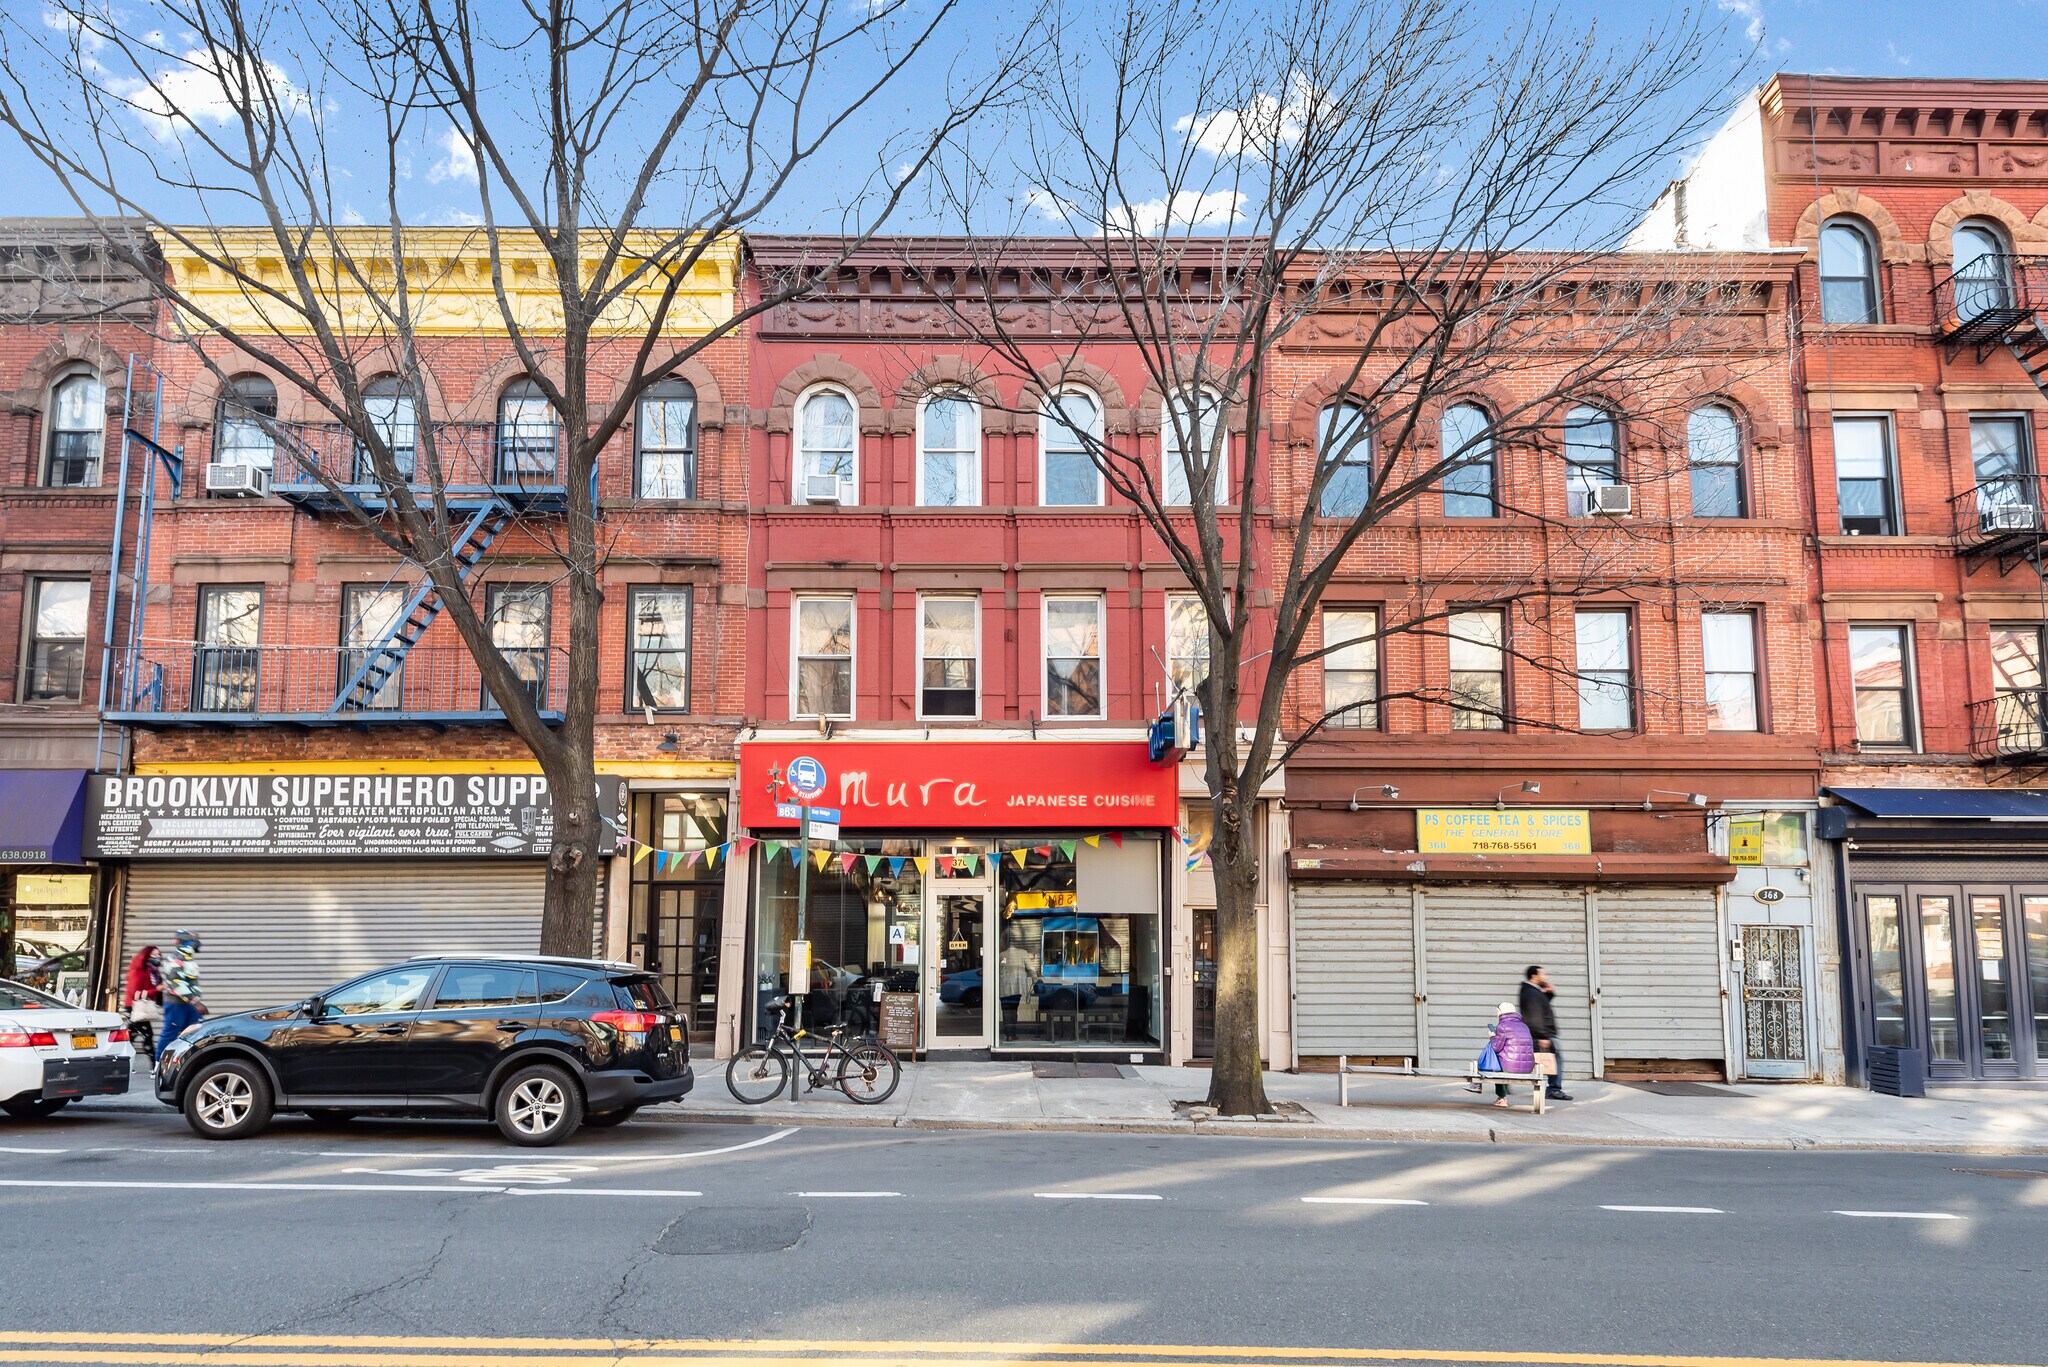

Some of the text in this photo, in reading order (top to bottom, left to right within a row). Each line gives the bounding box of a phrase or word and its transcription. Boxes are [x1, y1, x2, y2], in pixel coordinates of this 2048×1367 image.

[103, 776, 553, 807] BROOKLYN SUPERHERO SUPP
[790, 784, 823, 800] NO STANDING
[1006, 795, 1155, 807] JAPANESE CUISINE
[184, 806, 497, 816] SERVING BROOKLYN AND THE GREATER METROPOLITAN AREA
[780, 806, 796, 817] B63
[162, 820, 256, 828] EXCLUSIVE SOURCE FOR
[318, 816, 450, 824] DASTARDLY PLOTS WILL BE FOILED
[1425, 814, 1582, 827] PS COFFEE TEA & SPICES
[154, 828, 195, 836] AARDVARK
[223, 828, 262, 836] PRODUCTS
[398, 828, 421, 837] ever
[1444, 830, 1563, 838] THE GENERAL STORE
[1472, 842, 1537, 850] 718-768-5561
[1562, 842, 1580, 850] 368
[1763, 891, 1778, 900] 368
[892, 928, 902, 939] A
